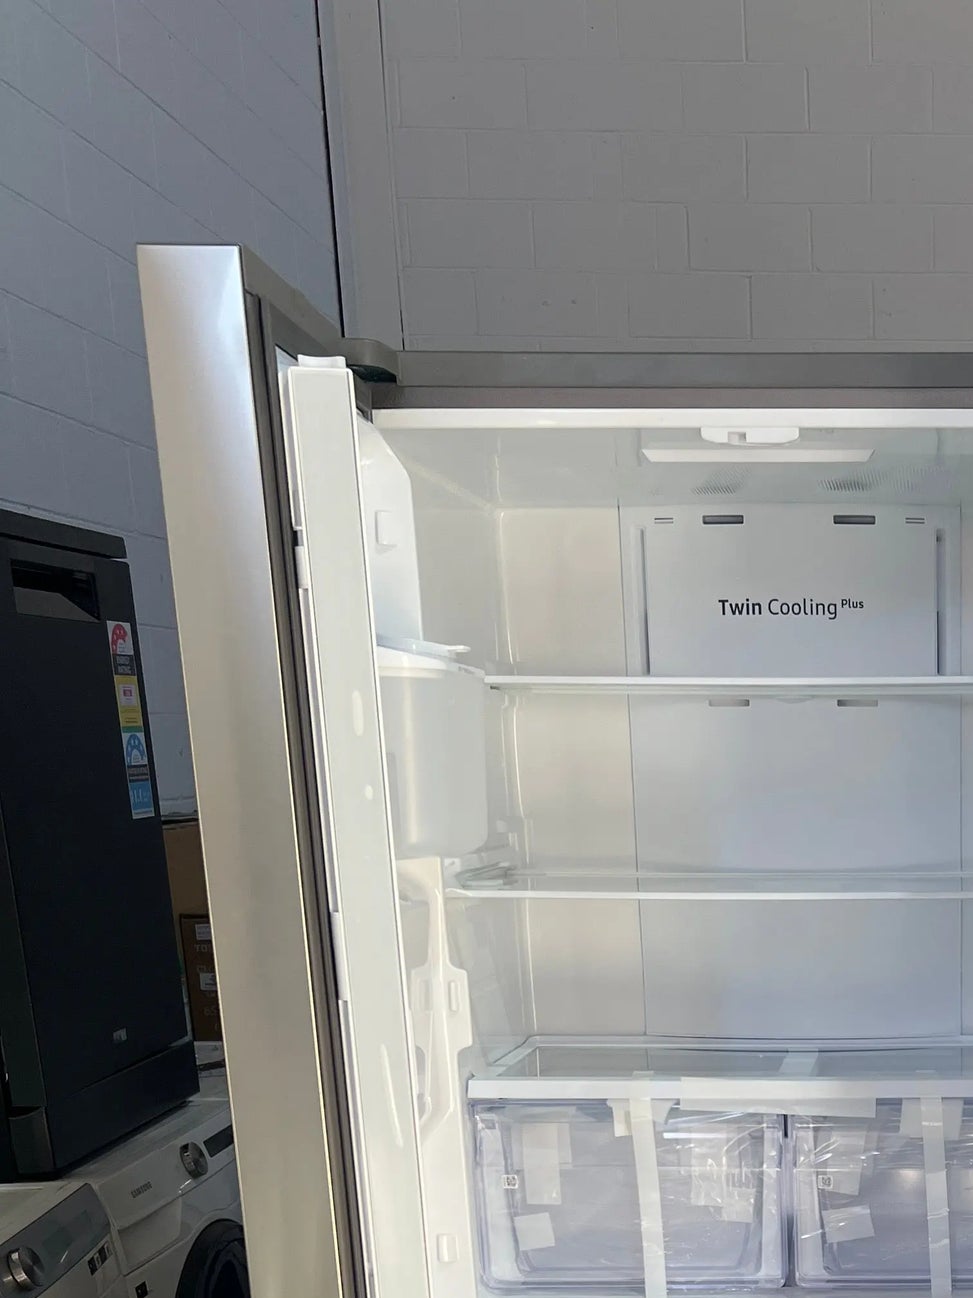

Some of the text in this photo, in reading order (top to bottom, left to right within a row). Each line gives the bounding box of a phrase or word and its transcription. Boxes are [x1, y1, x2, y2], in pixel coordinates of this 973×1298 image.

[718, 598, 865, 620] Twin Cooling Plus
